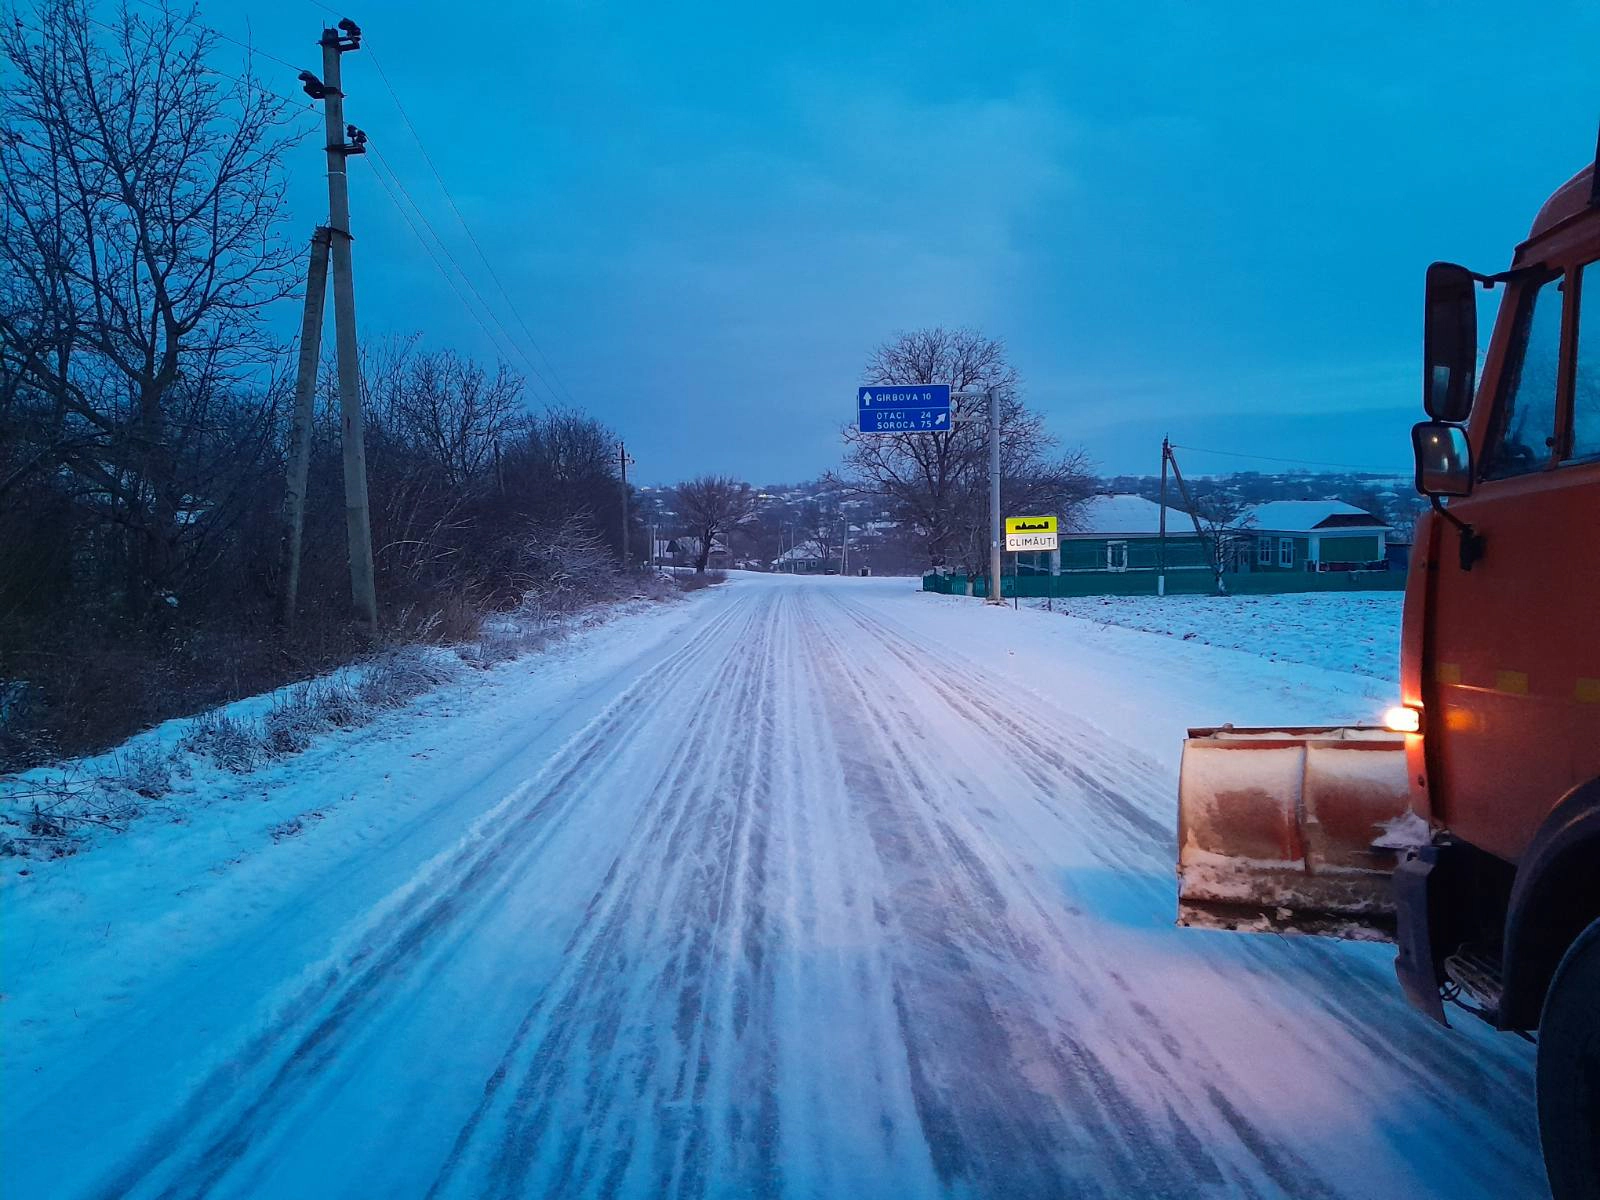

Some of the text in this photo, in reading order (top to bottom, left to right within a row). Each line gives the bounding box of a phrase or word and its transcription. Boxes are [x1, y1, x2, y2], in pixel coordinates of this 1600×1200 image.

[922, 392, 932, 400] 10
[876, 411, 931, 420] OTACI 24
[877, 420, 932, 430] SOROCA 75
